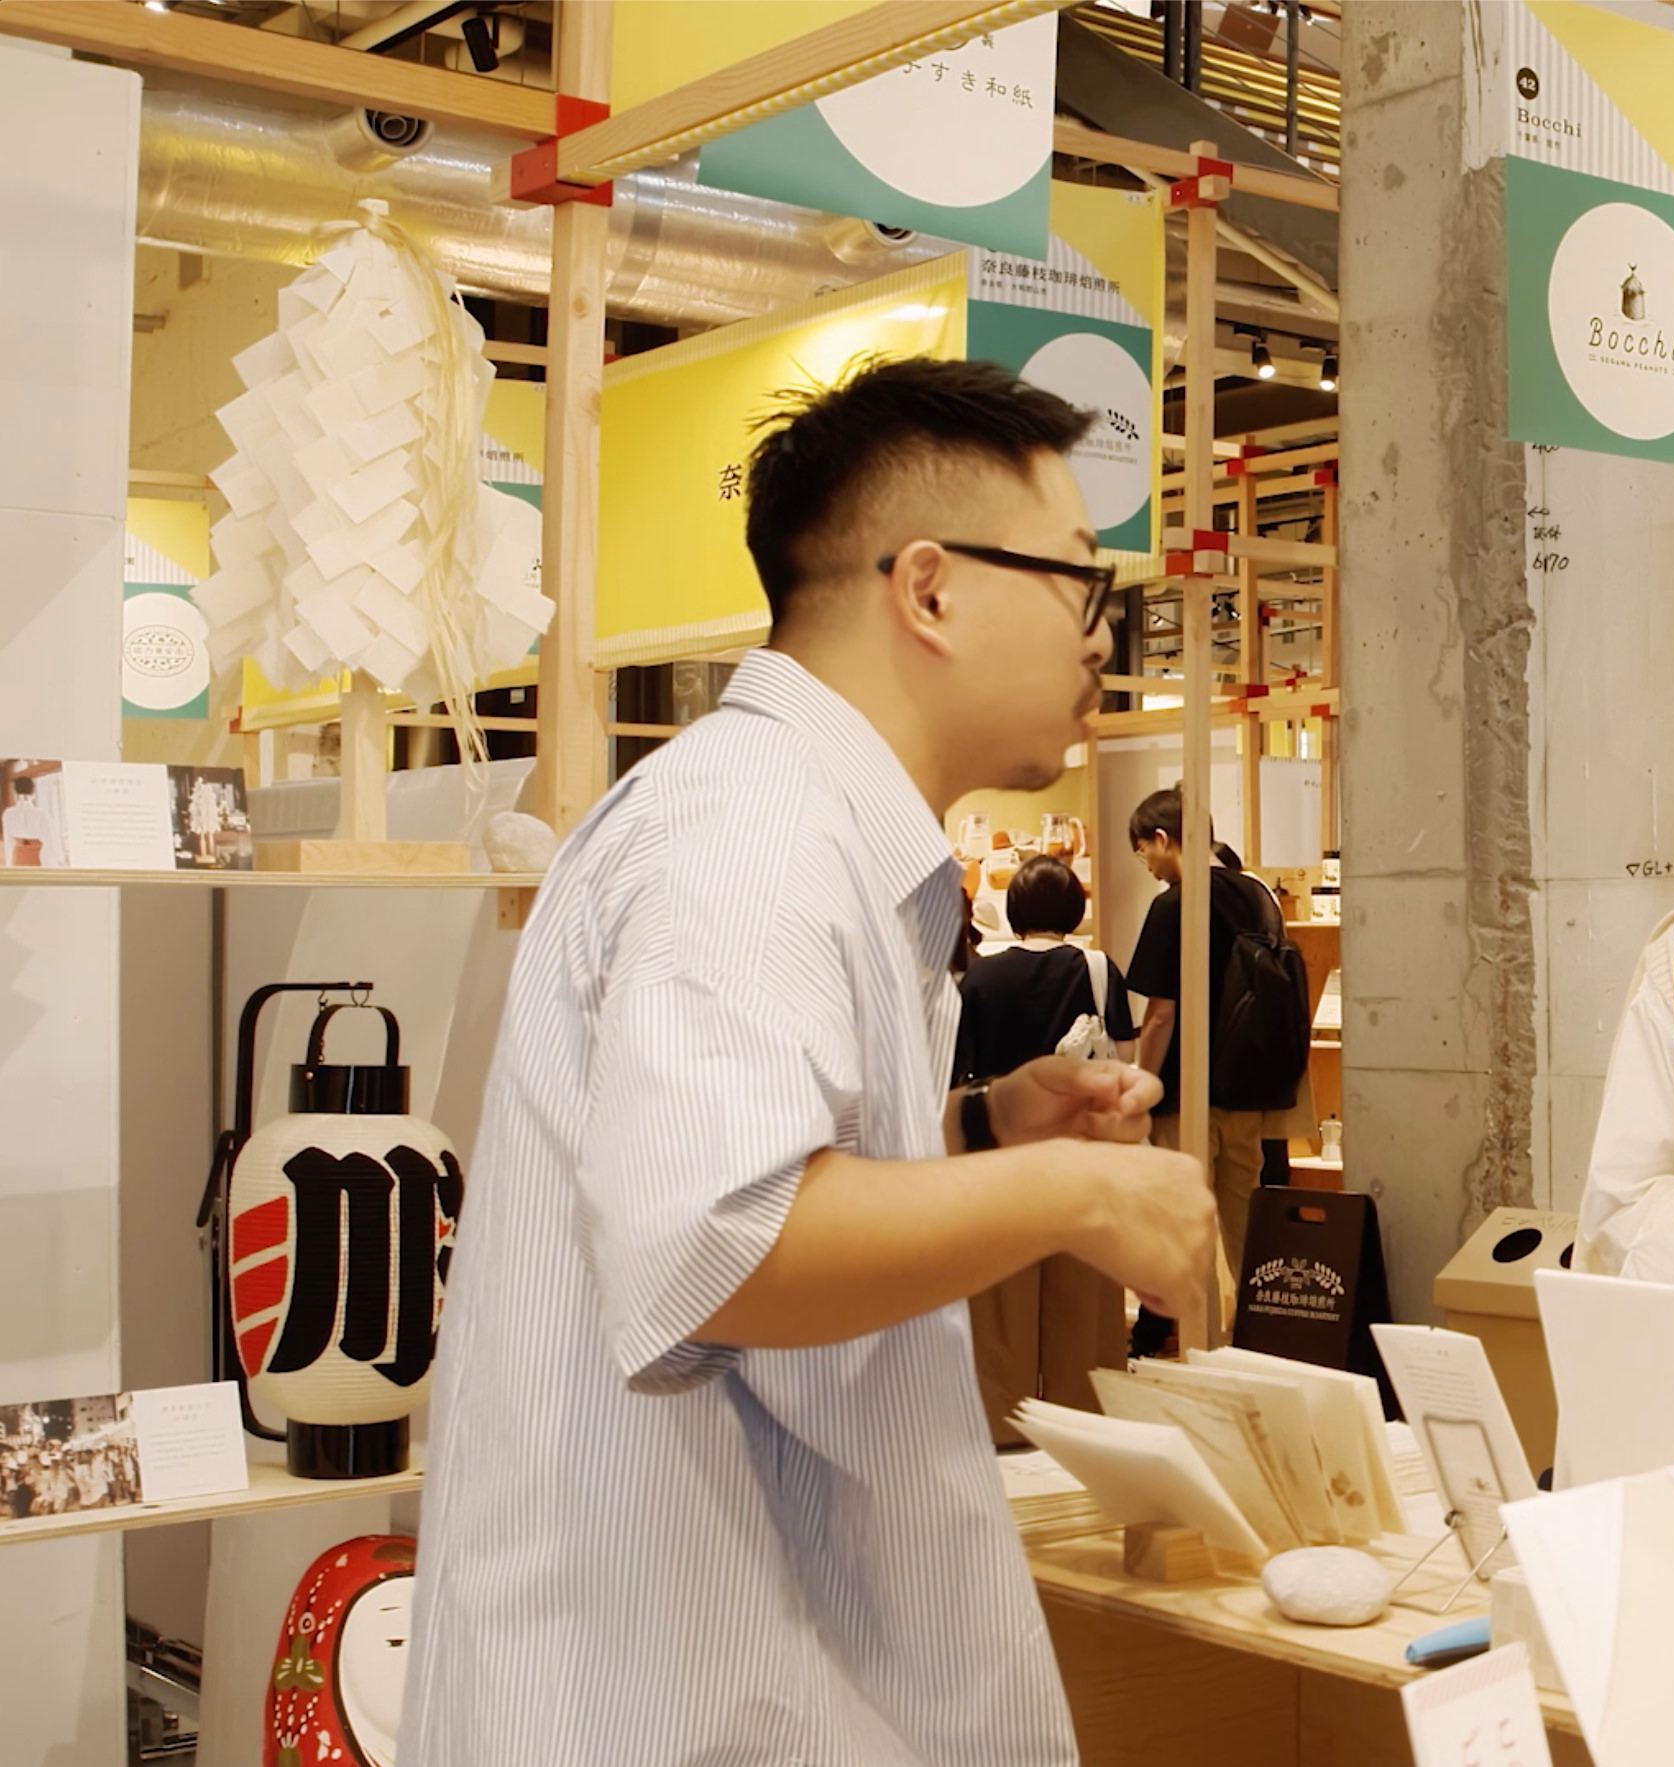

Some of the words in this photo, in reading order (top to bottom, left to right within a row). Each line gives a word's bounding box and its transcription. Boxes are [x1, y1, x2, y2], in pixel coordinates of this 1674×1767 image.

[1520, 77, 1536, 91] 42
[1518, 107, 1582, 138] Bocchi
[1533, 552, 1569, 574] 6170
